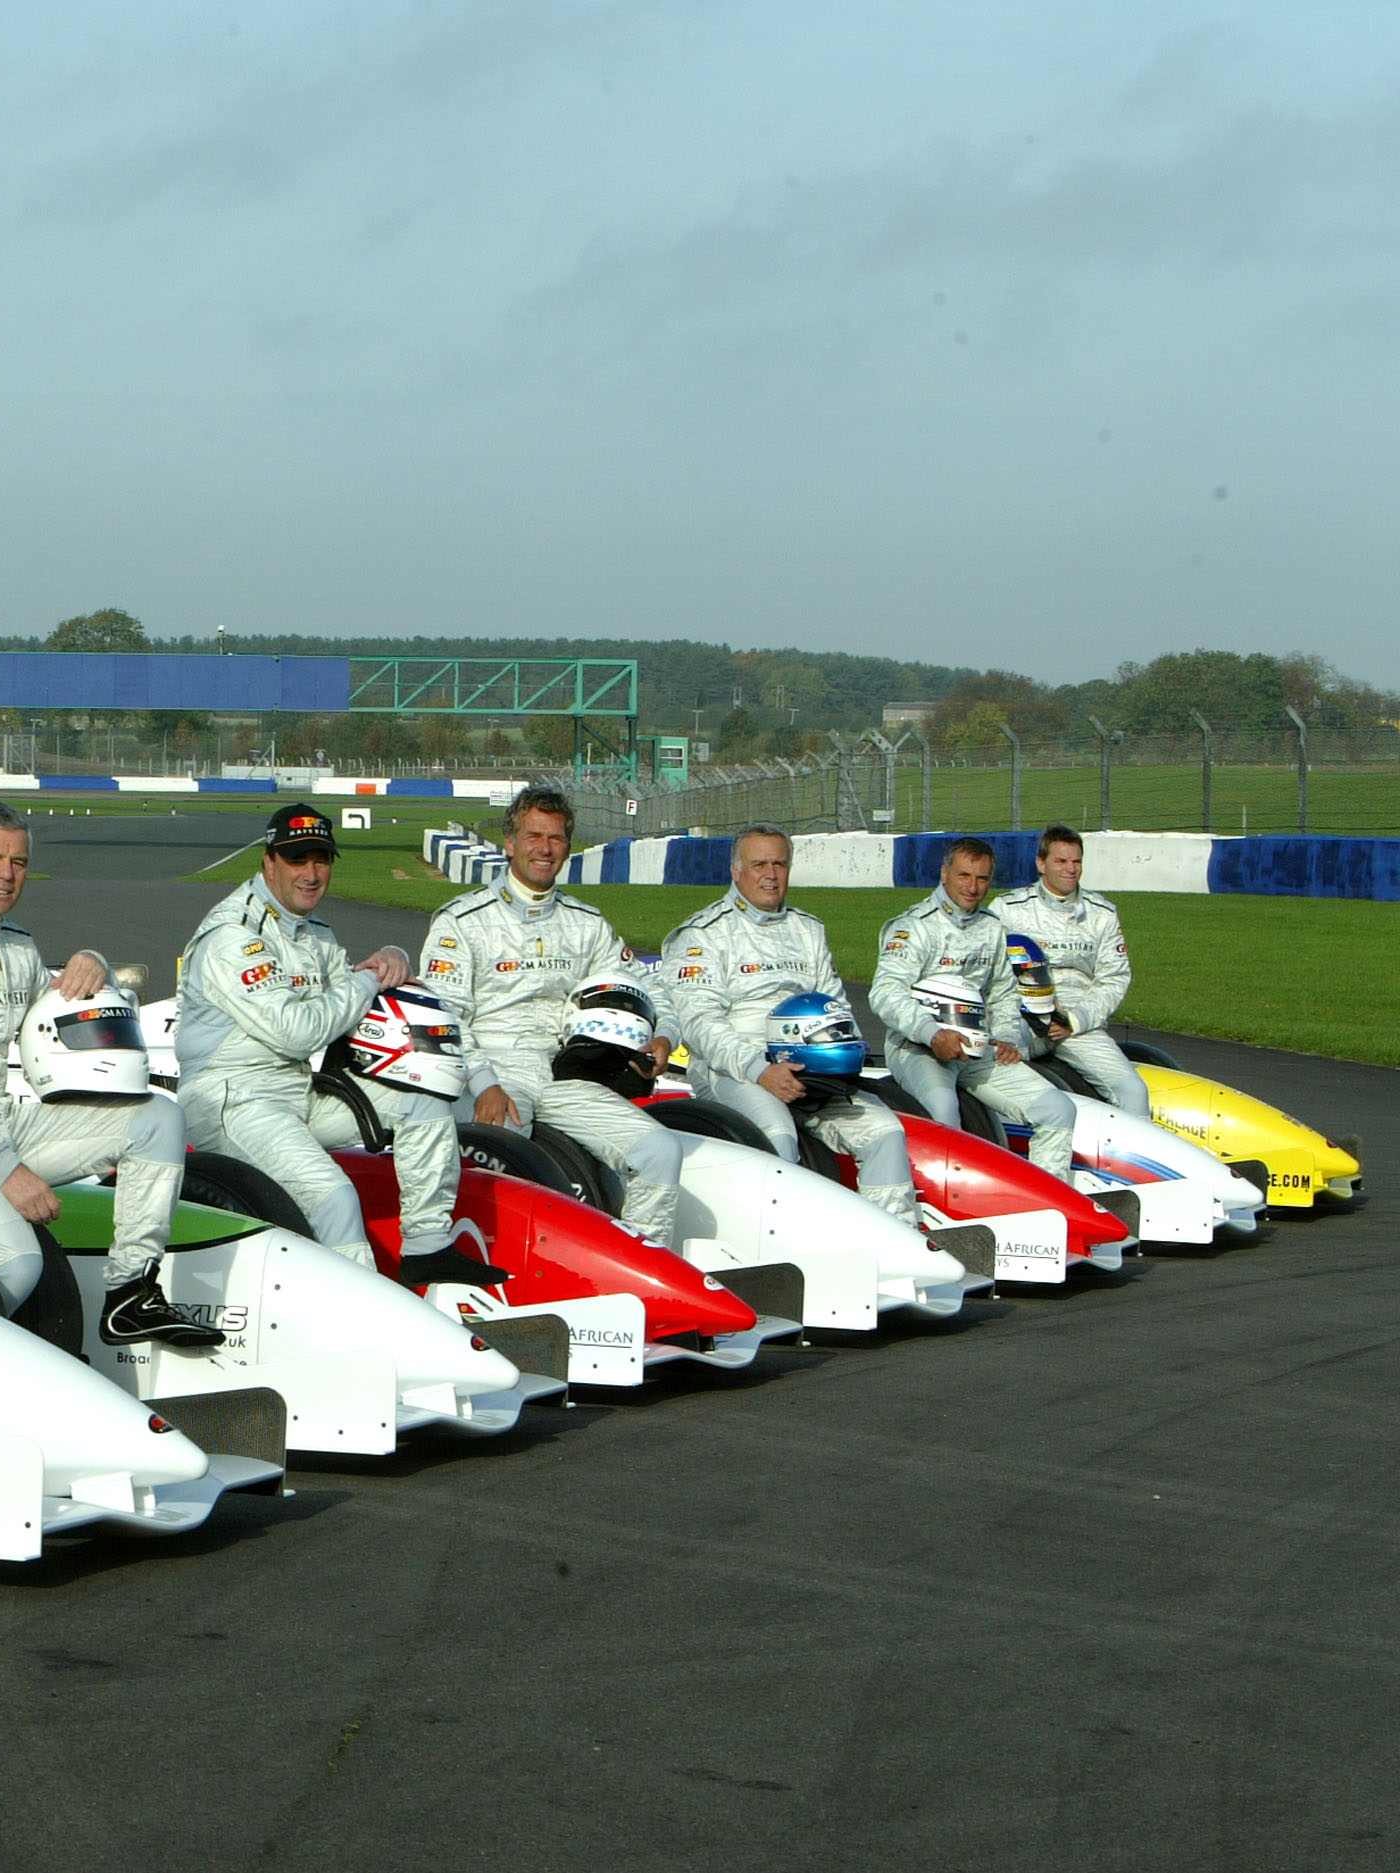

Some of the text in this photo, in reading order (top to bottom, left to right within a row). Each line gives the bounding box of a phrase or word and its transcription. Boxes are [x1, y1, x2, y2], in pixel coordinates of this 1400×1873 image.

[628, 801, 636, 813] F
[1004, 1241, 1060, 1257] AFRICAN
[569, 1326, 634, 1345] AFRICAN
